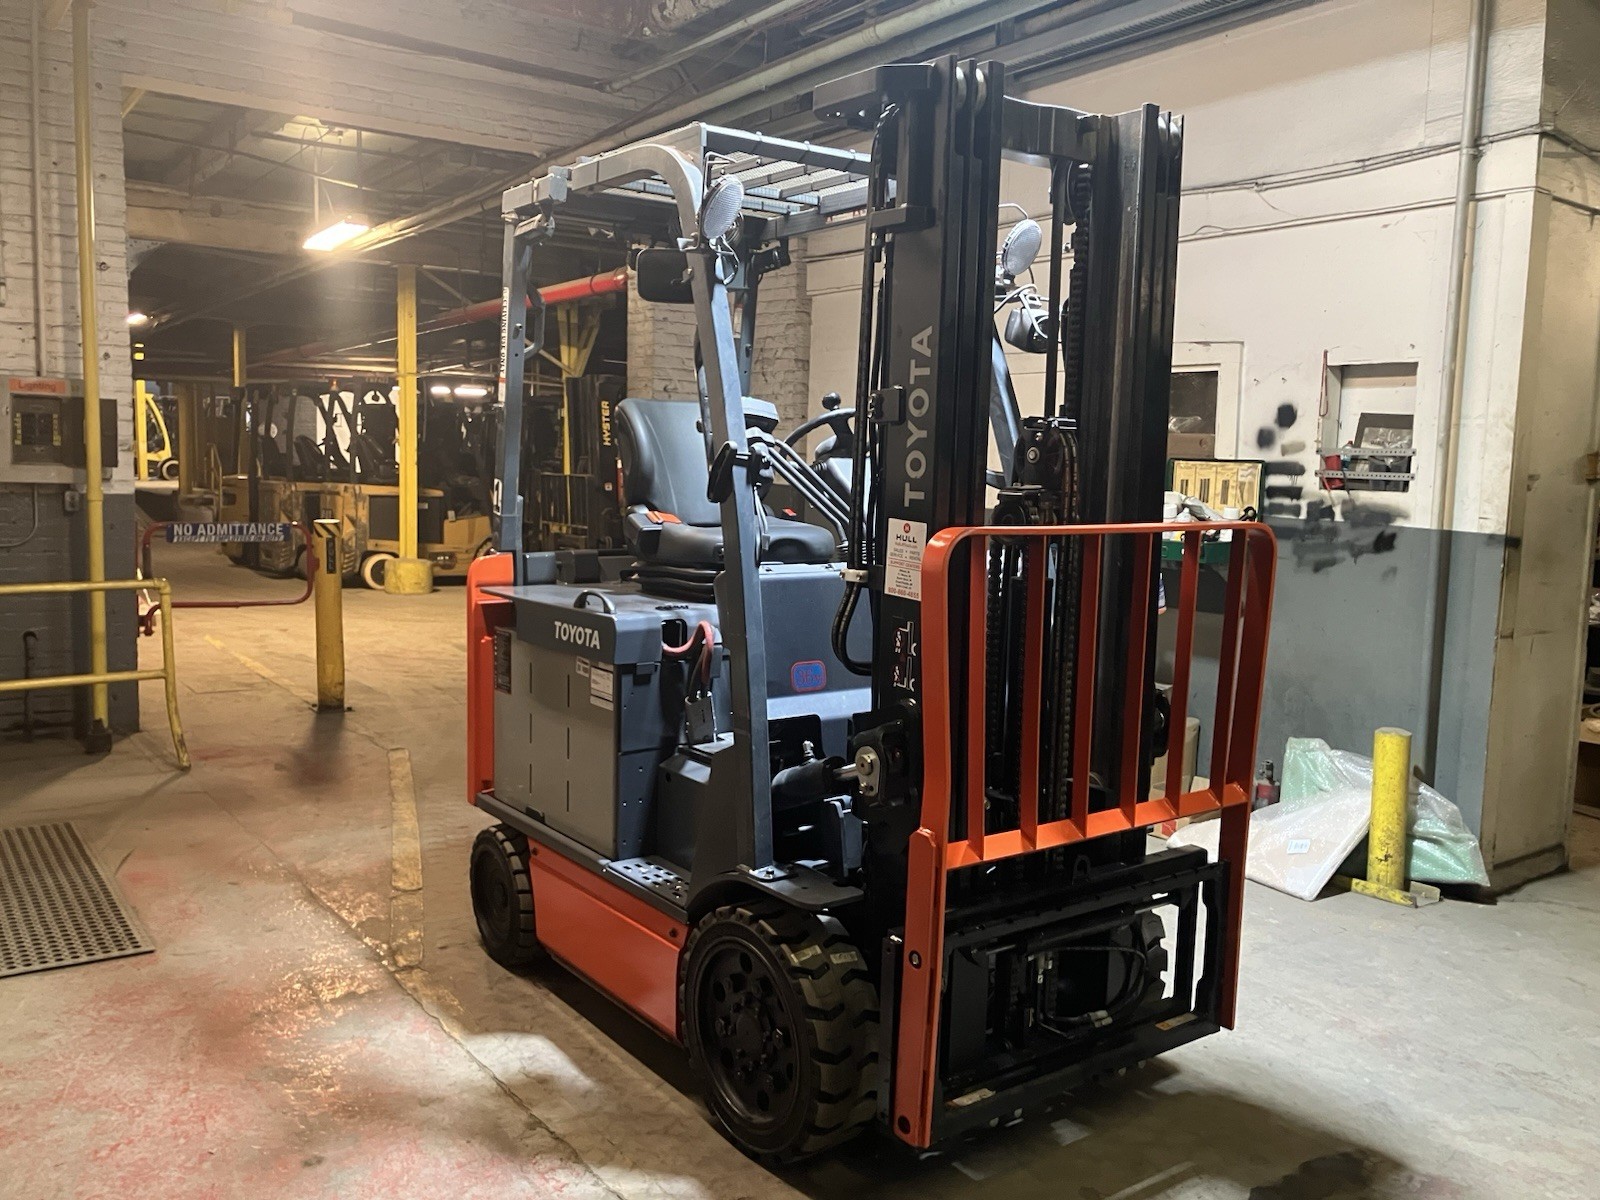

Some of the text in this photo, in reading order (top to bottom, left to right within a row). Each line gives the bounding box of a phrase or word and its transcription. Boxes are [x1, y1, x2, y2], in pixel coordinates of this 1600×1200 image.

[601, 400, 611, 446] HYSTER
[904, 325, 933, 507] TOYOTA
[173, 522, 283, 535] NO ADMITTANCE
[896, 534, 917, 543] HULL
[554, 621, 600, 650] TOYOTA
